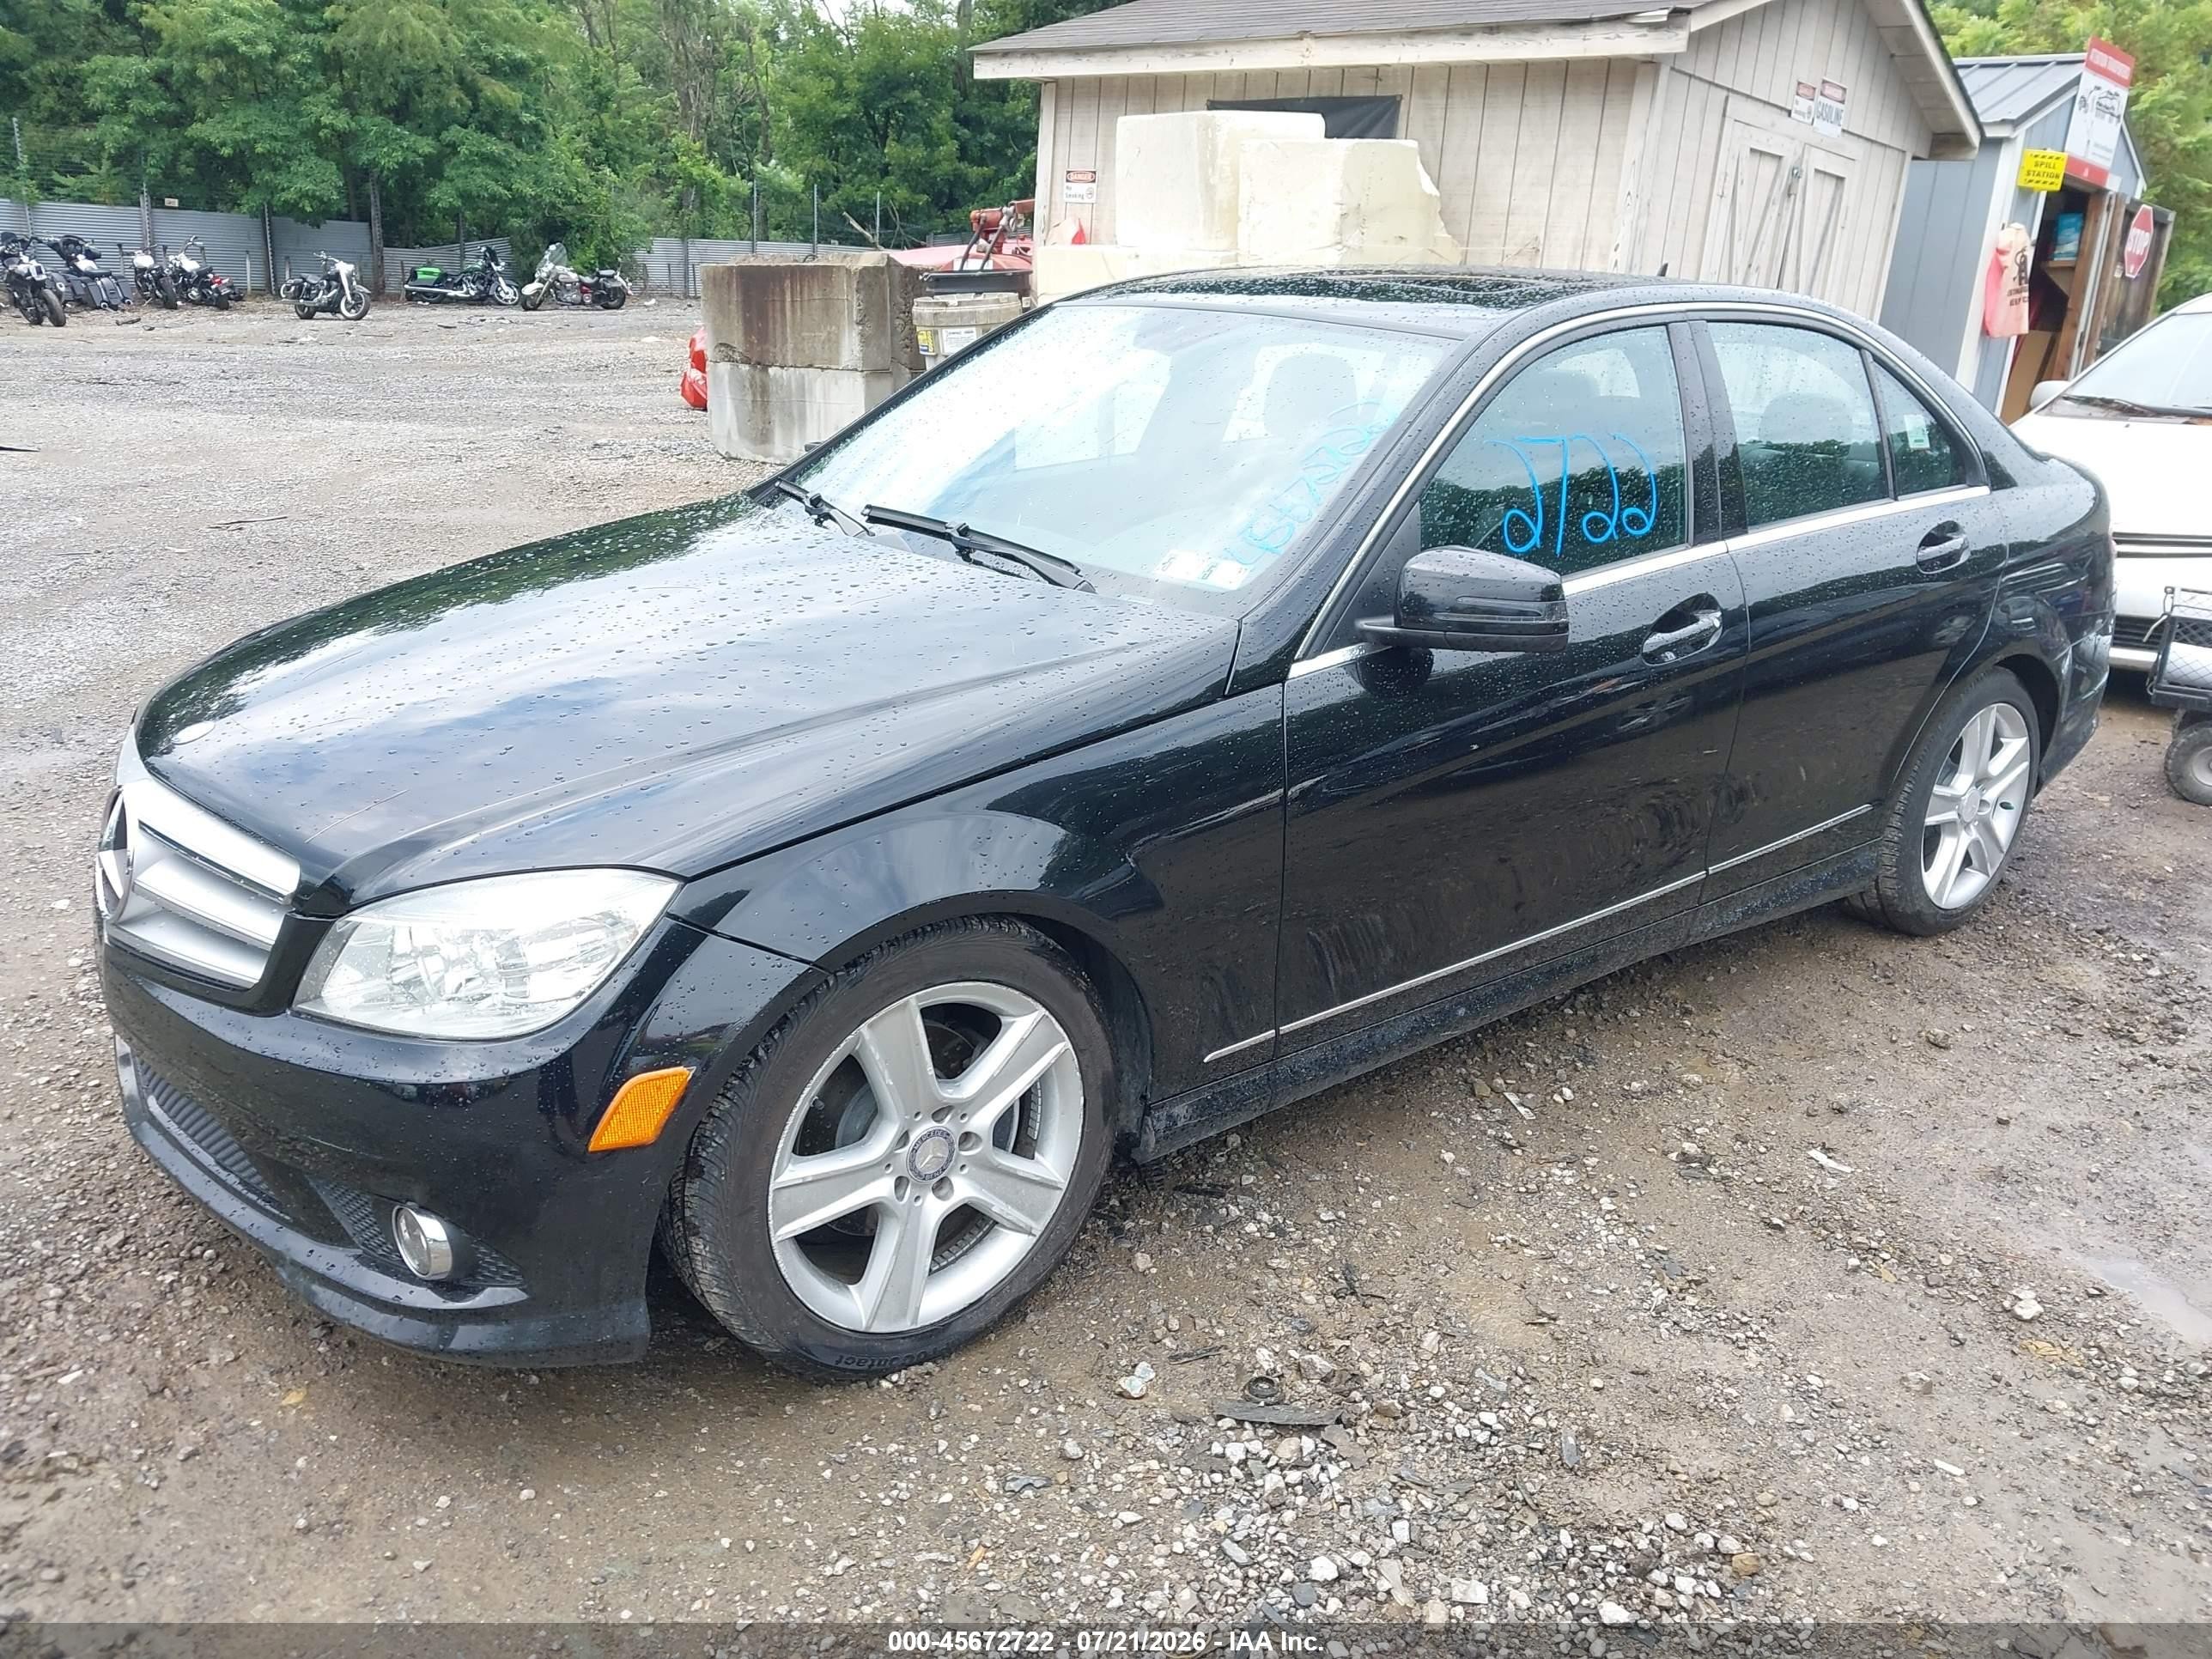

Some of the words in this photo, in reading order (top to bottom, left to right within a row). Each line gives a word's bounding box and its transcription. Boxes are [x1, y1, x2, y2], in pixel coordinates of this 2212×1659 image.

[1816, 100, 1844, 126] GASOLINE
[2027, 170, 2060, 179] STATION
[2034, 161, 2057, 169] SPILL
[2128, 227, 2151, 256] STOP
[1483, 433, 1659, 558] 2722
[913, 1129, 951, 1152] MERCEDES
[925, 1167, 946, 1181] BENZ
